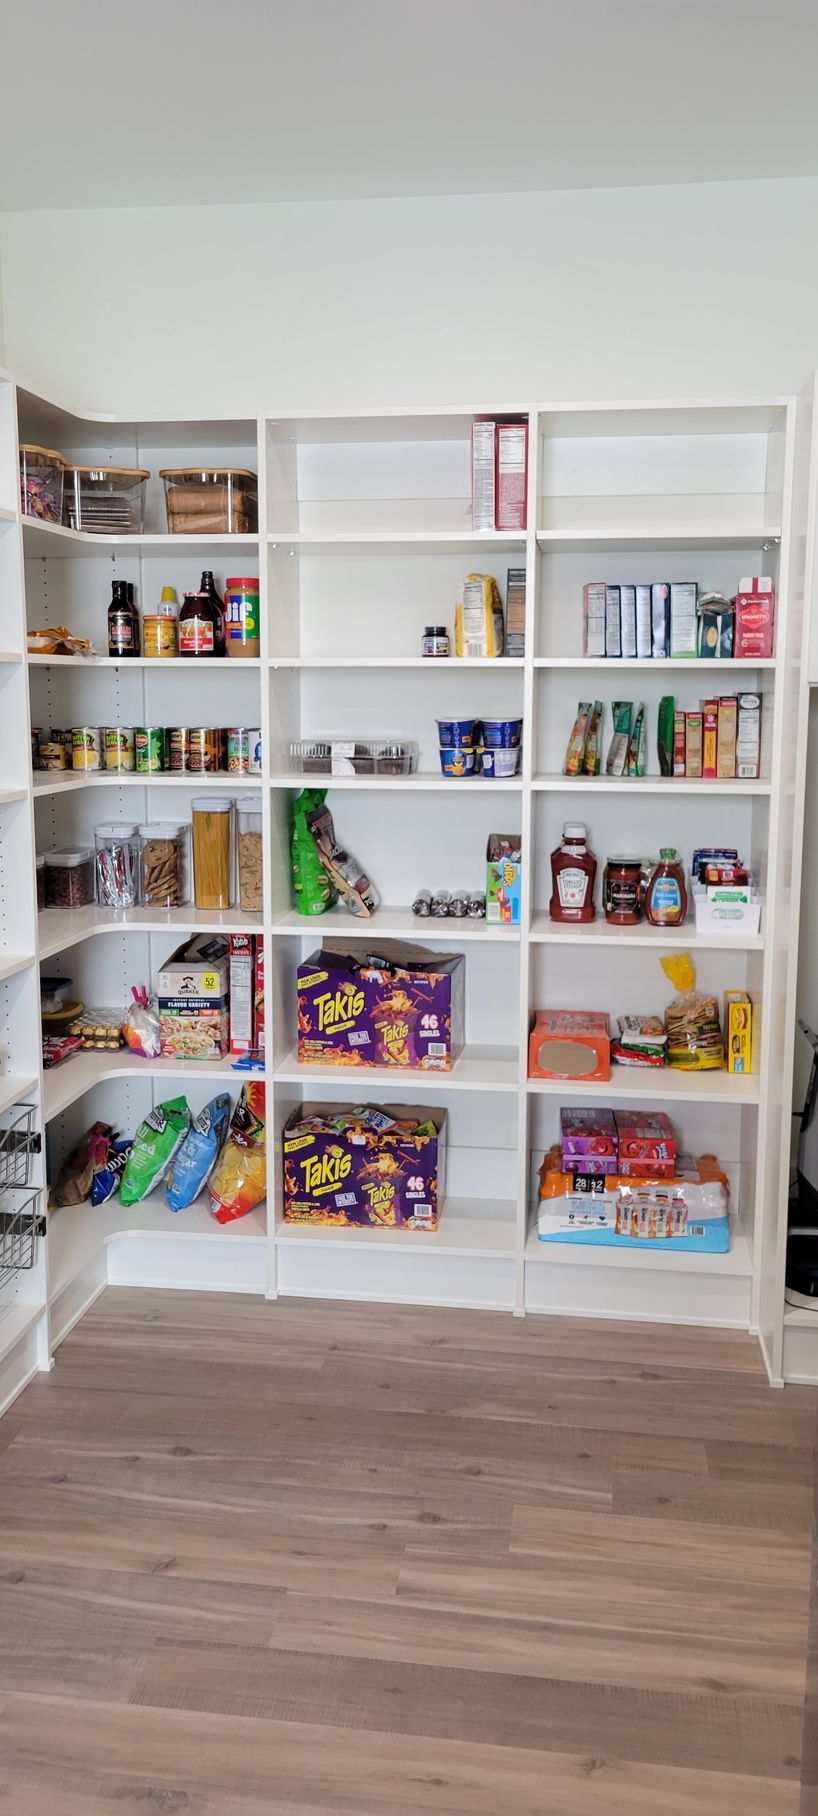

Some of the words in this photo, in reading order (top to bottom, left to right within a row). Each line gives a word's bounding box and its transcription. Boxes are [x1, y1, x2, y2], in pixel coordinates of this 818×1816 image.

[224, 601, 253, 622] Jif
[205, 977, 215, 987] 52
[313, 988, 365, 1031] Takis
[421, 1014, 439, 1030] 46
[381, 1023, 409, 1045] Takis
[300, 1151, 352, 1193] Takis
[406, 1176, 424, 1191] 46
[575, 1178, 587, 1188] 28
[368, 1183, 395, 1206] Takis
